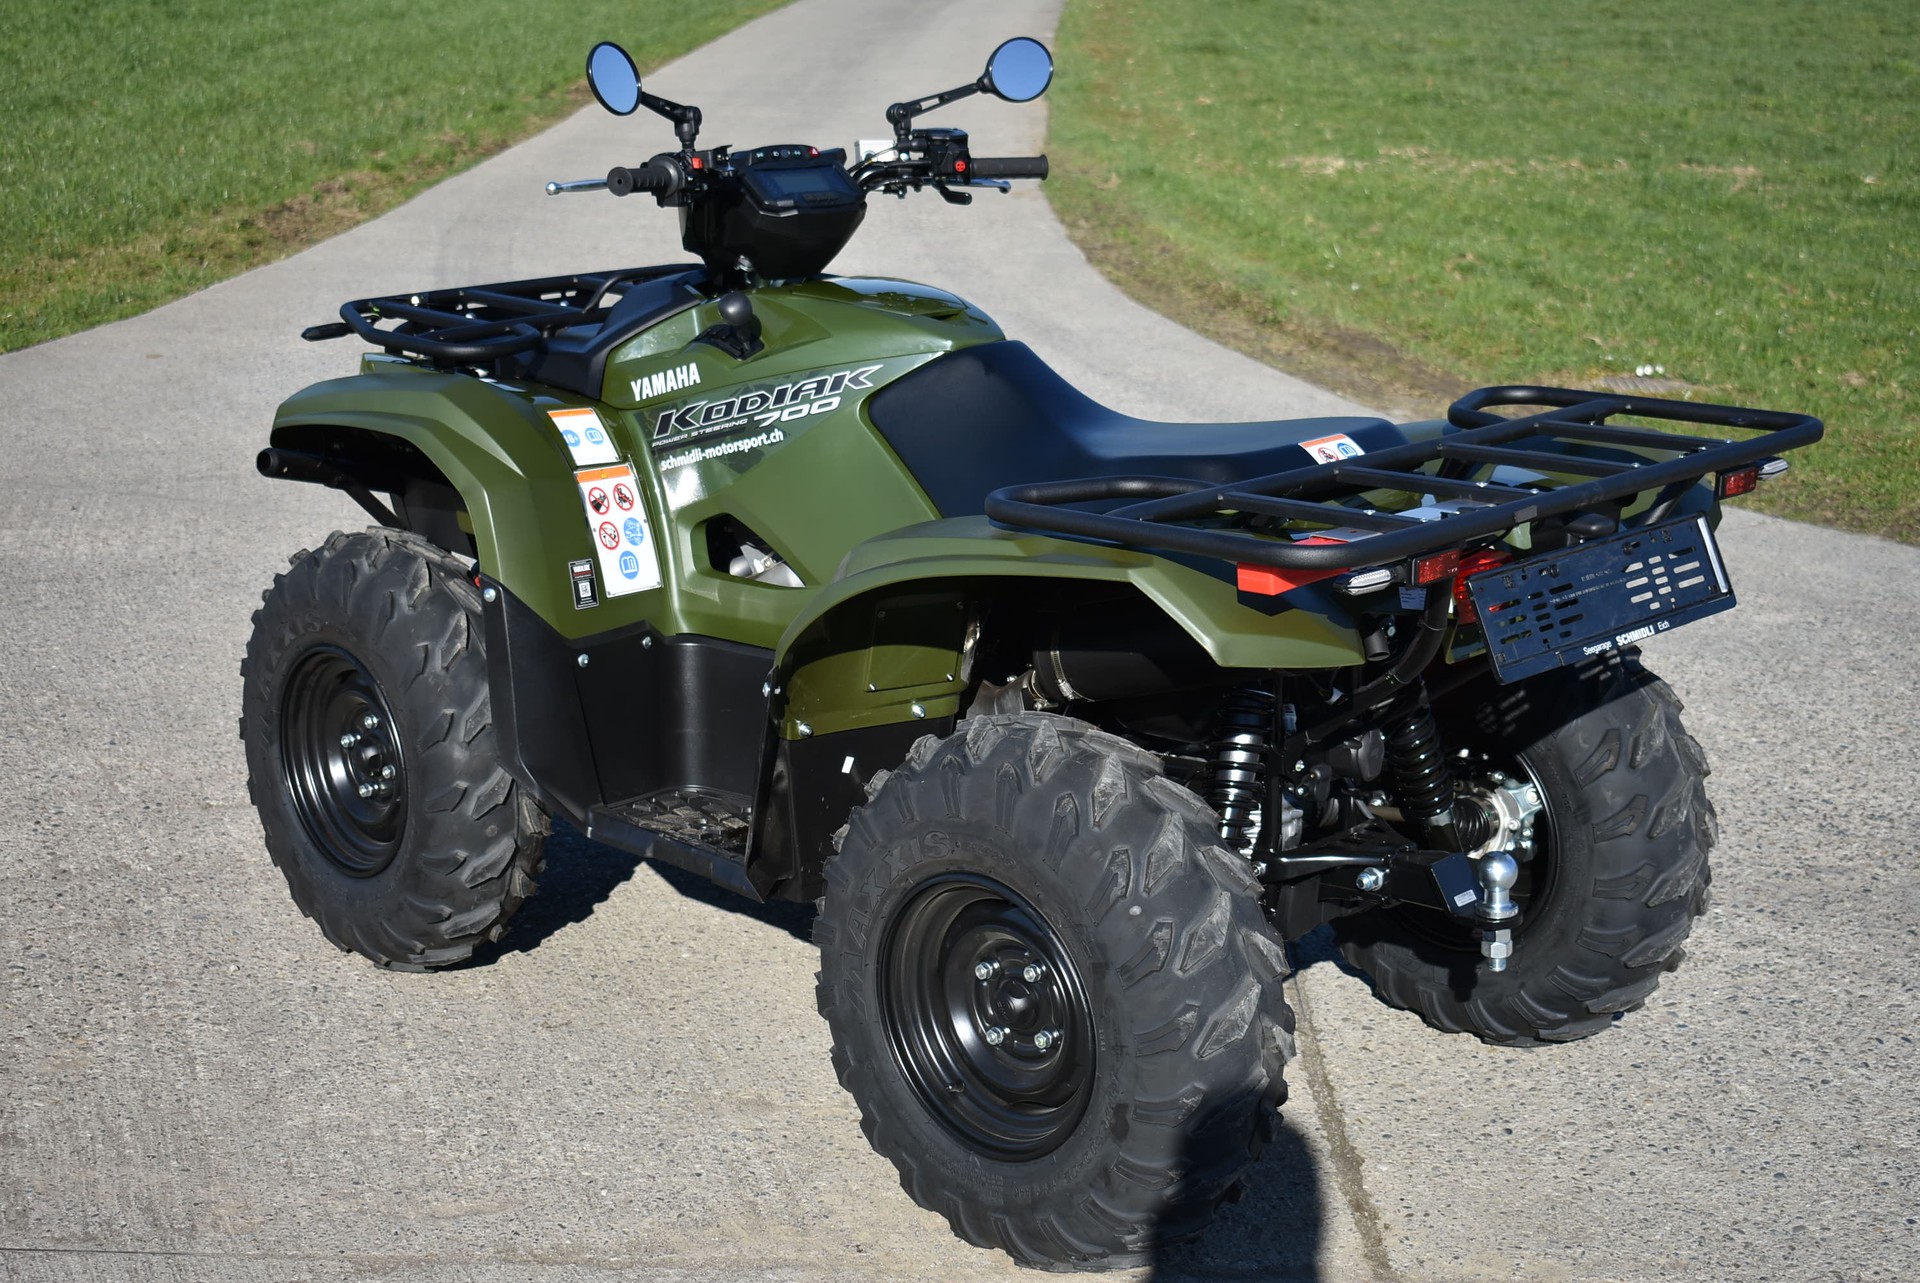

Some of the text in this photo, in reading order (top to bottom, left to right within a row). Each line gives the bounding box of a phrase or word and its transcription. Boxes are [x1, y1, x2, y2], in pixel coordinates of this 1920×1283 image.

[631, 362, 701, 401] YAMAHA
[653, 364, 884, 440] KODIAK
[753, 396, 842, 428] 700
[651, 418, 749, 448] POWER STEERING
[660, 427, 784, 472] schmidli-motorsport.ch
[1582, 619, 1670, 656] Seegarage SCHMIDLI Eich
[840, 830, 951, 1024] MAXXIS
